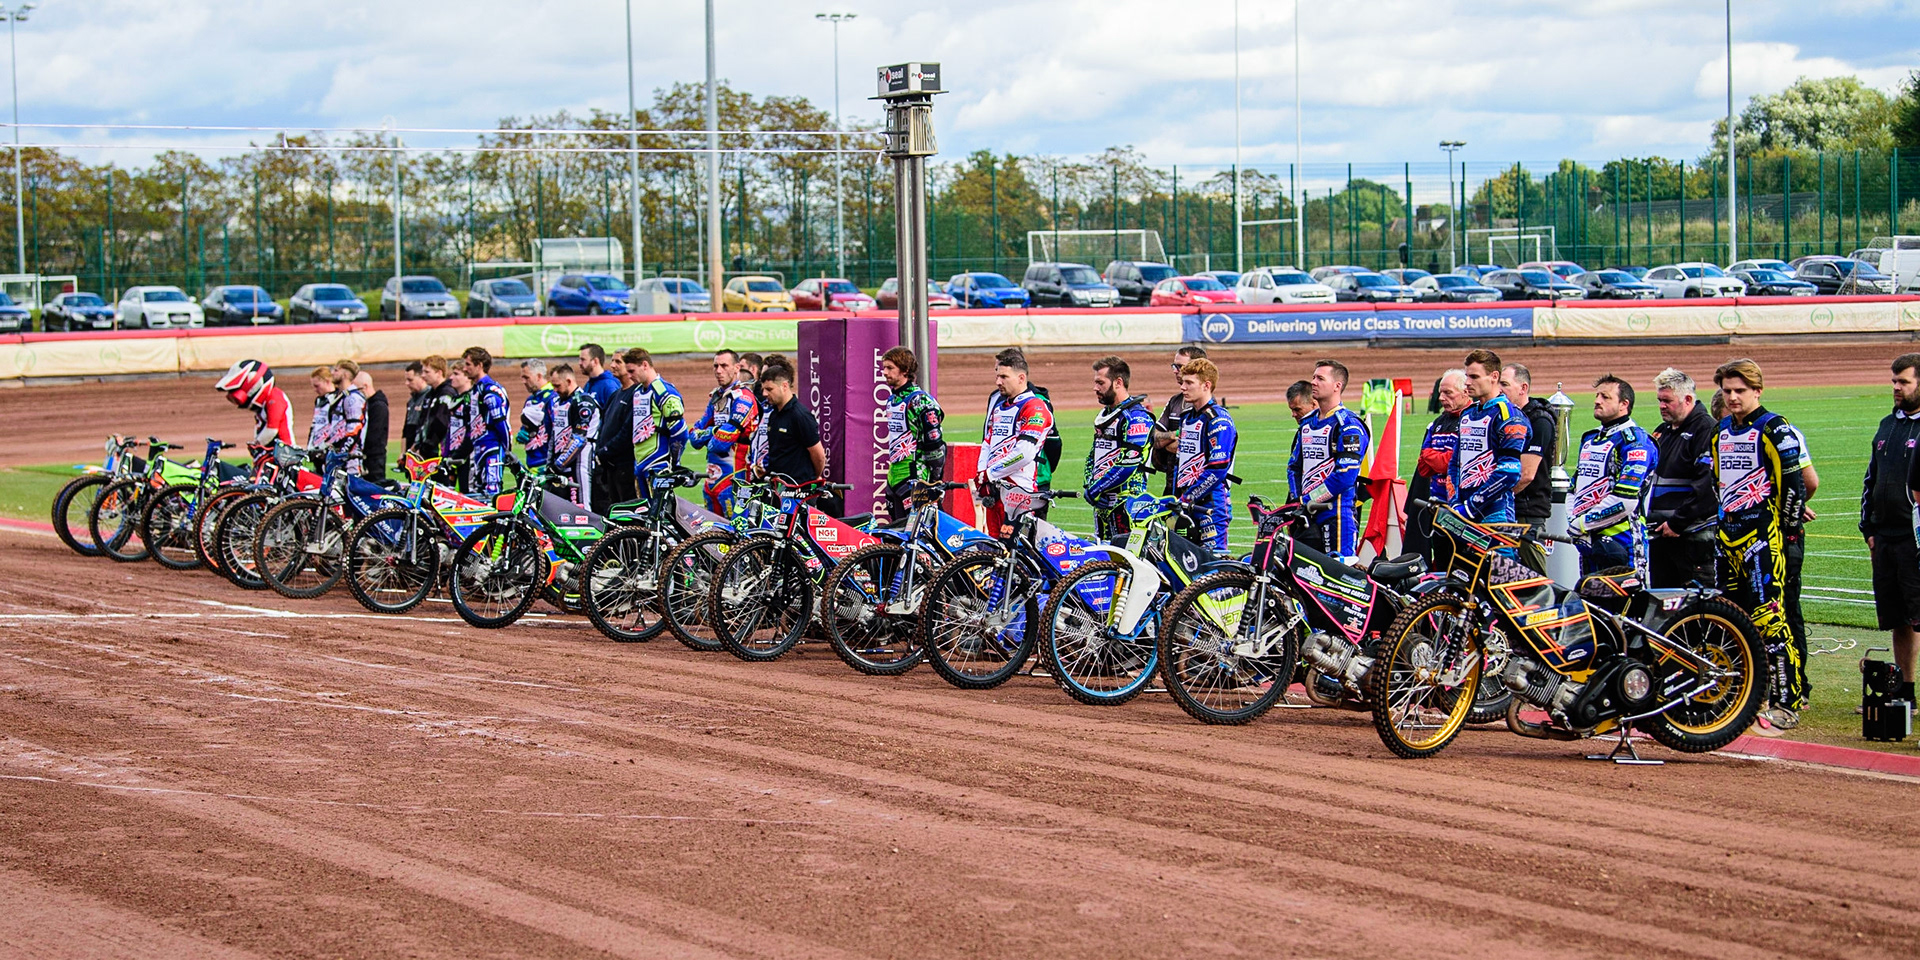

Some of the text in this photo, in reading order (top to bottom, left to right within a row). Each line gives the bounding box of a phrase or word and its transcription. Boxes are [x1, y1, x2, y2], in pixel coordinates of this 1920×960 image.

[1207, 314, 1513, 335] ATPI Delivering World Class Travel Solutions
[768, 328, 797, 340] EVEN
[1628, 450, 1646, 458] NGK
[1720, 460, 1753, 470] 2022
[817, 528, 836, 538] NGK
[1662, 597, 1682, 611] 57
